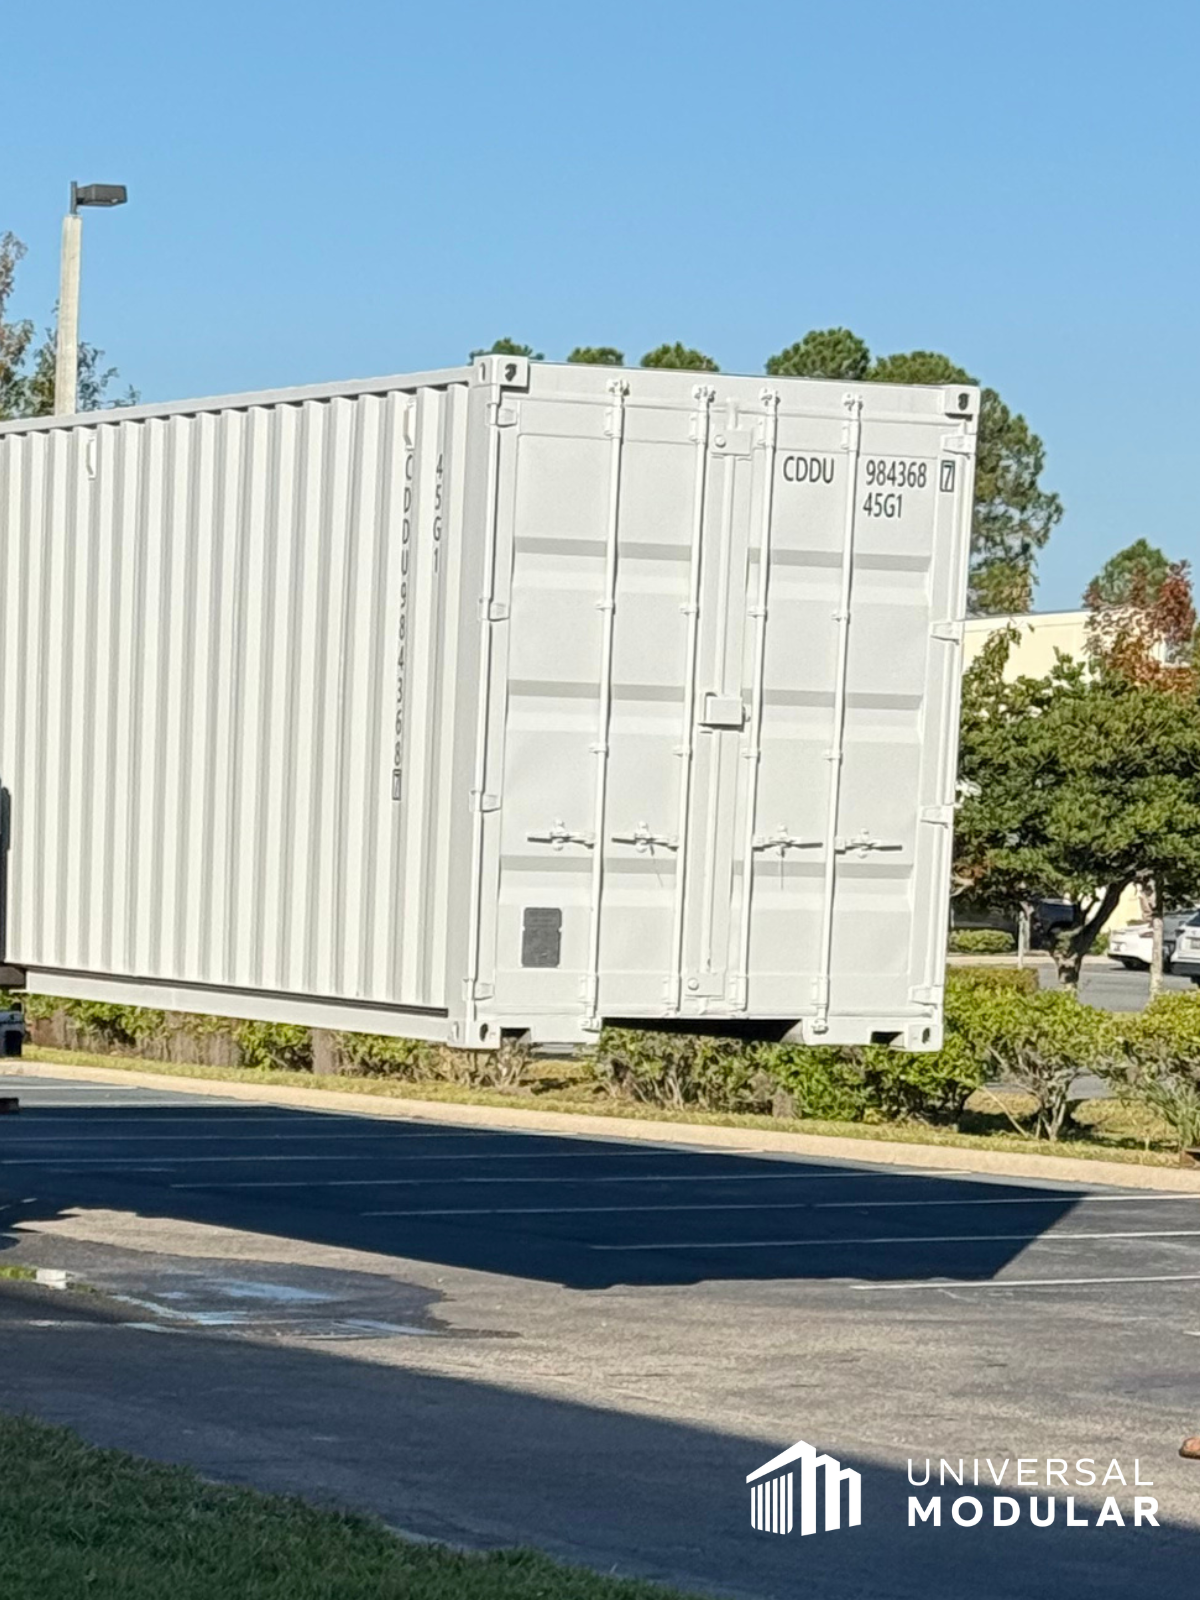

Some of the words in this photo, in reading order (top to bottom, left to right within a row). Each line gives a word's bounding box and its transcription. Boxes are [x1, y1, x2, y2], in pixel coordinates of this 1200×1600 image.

[783, 456, 834, 483] CDDU
[866, 459, 927, 488] 984368
[941, 462, 954, 491] 7
[433, 454, 444, 573] 45G1
[863, 493, 902, 518] 45G1
